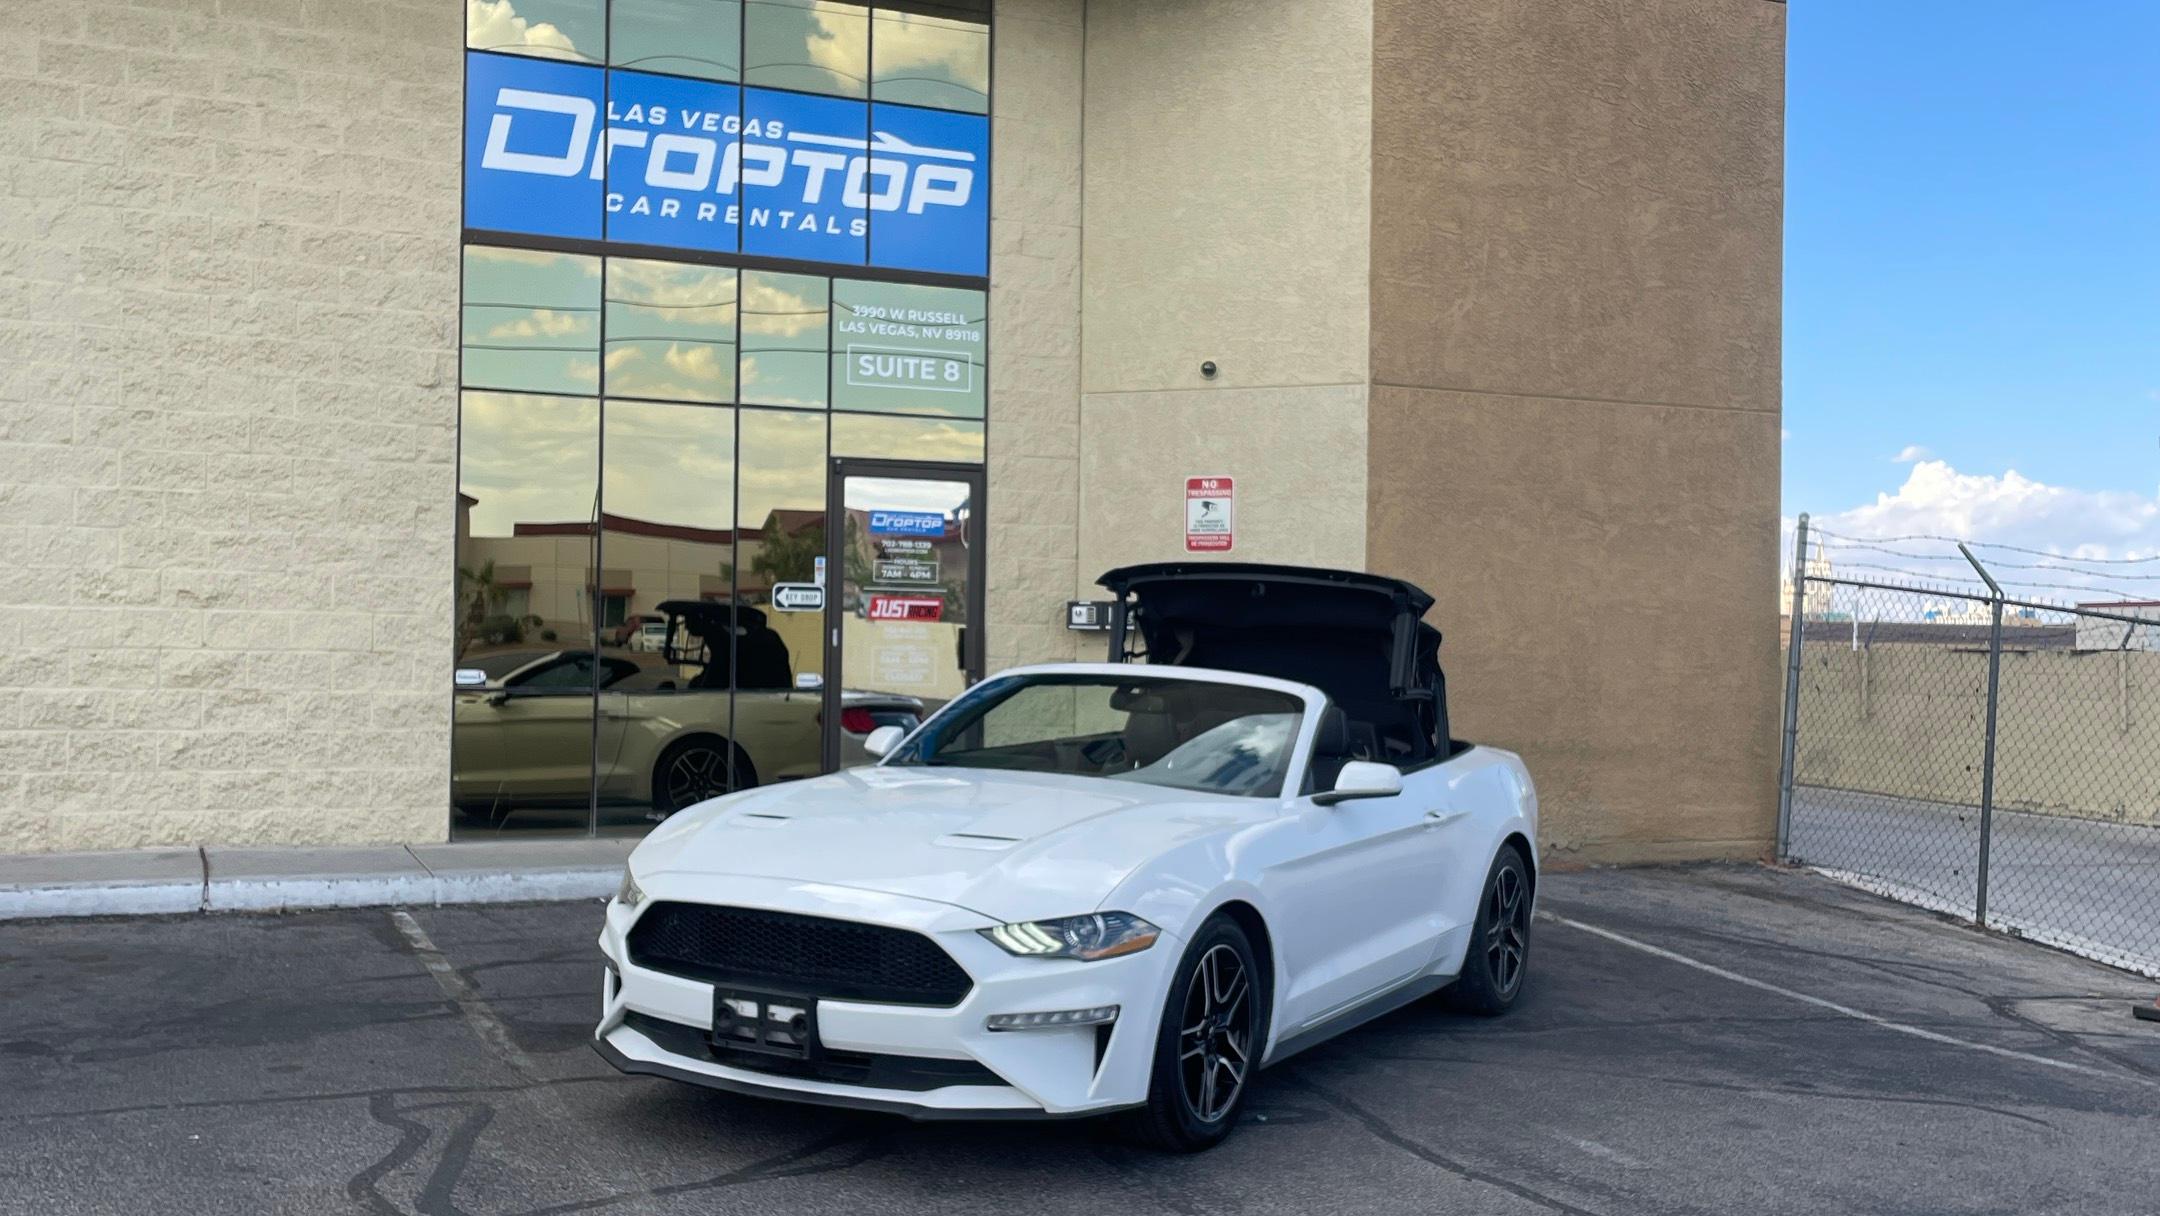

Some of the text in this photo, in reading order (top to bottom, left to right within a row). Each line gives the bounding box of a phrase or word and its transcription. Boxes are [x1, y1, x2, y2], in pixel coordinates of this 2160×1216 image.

[607, 101, 785, 140] LAS VEGAS
[606, 193, 868, 237] CAR RENTALS
[852, 304, 968, 326] 3990 W RUSSELL
[839, 320, 981, 342] LAS VEGAS, NV 89118
[858, 355, 961, 382] SUITE 8
[1201, 480, 1217, 489] NO
[871, 599, 913, 618] JUST
